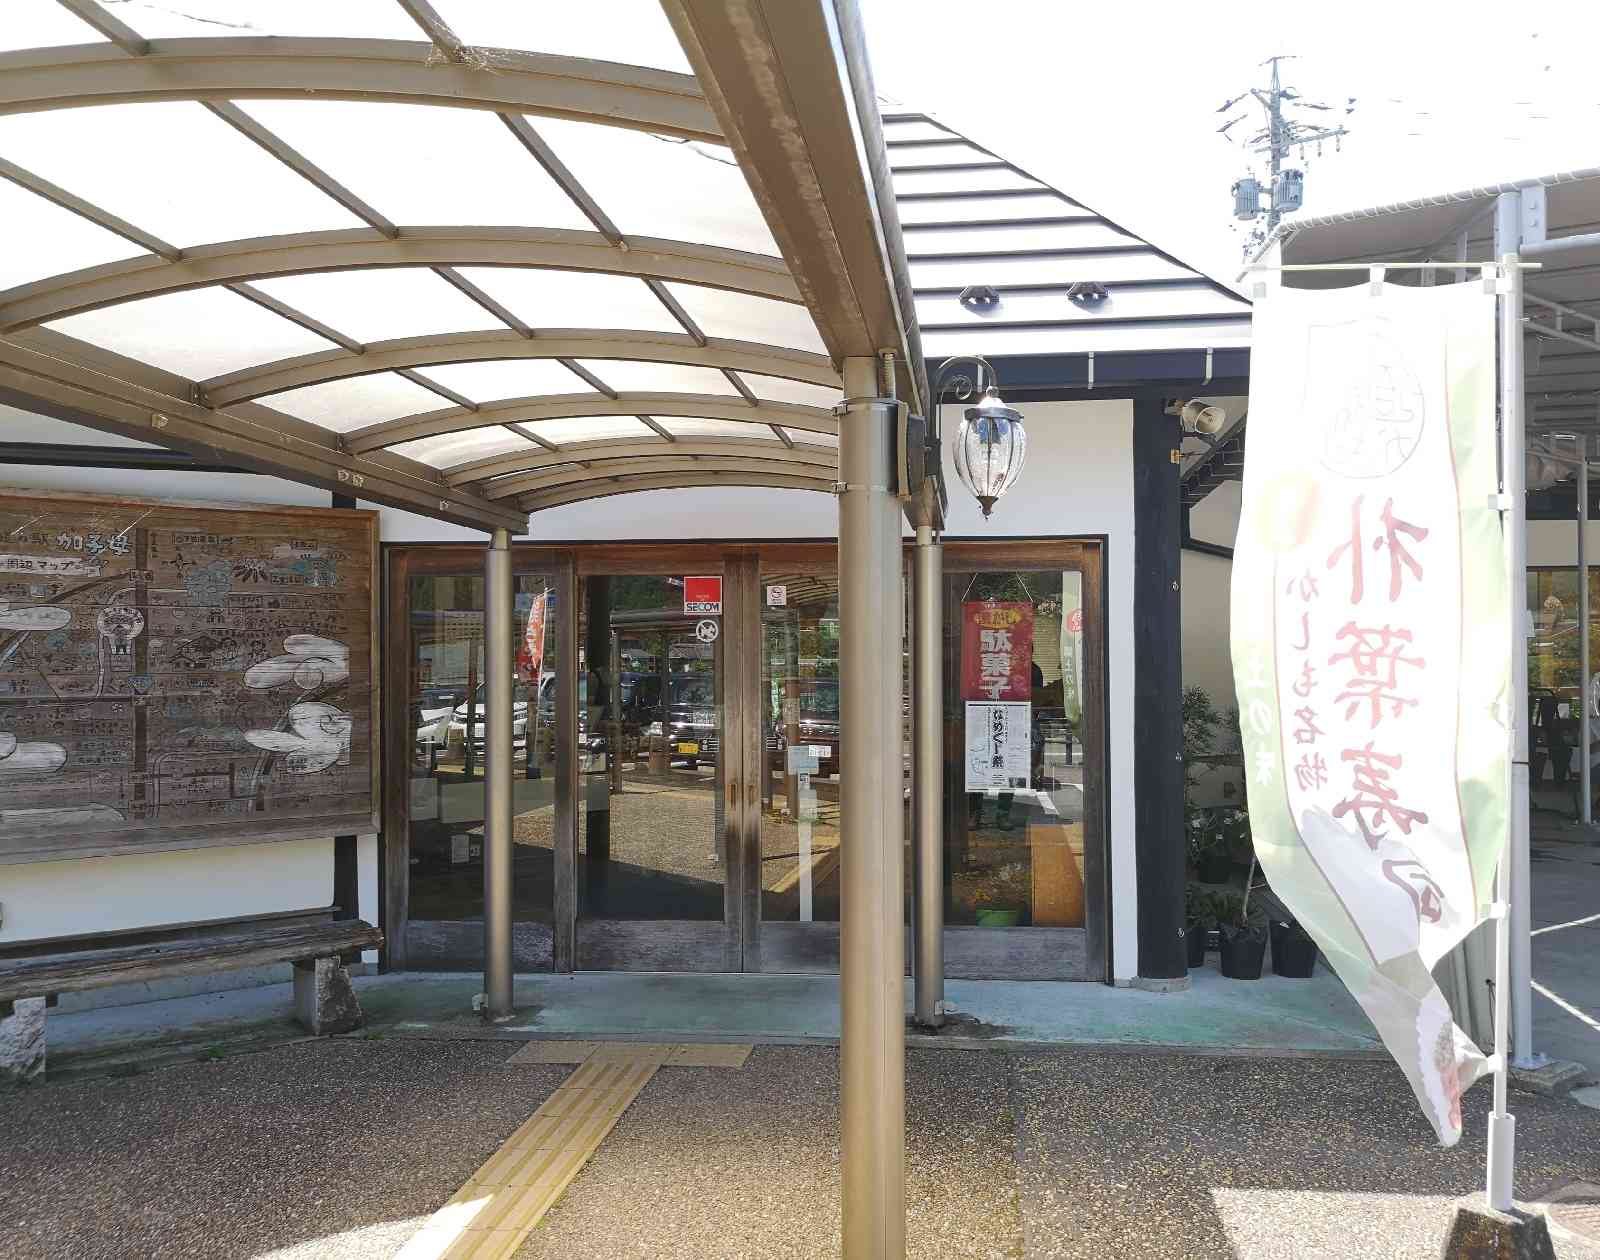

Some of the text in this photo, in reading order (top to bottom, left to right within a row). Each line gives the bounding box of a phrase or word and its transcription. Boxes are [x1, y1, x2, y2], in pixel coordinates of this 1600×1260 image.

[686, 602, 720, 612] SECOM
[979, 629, 1013, 701] 駄菓子
